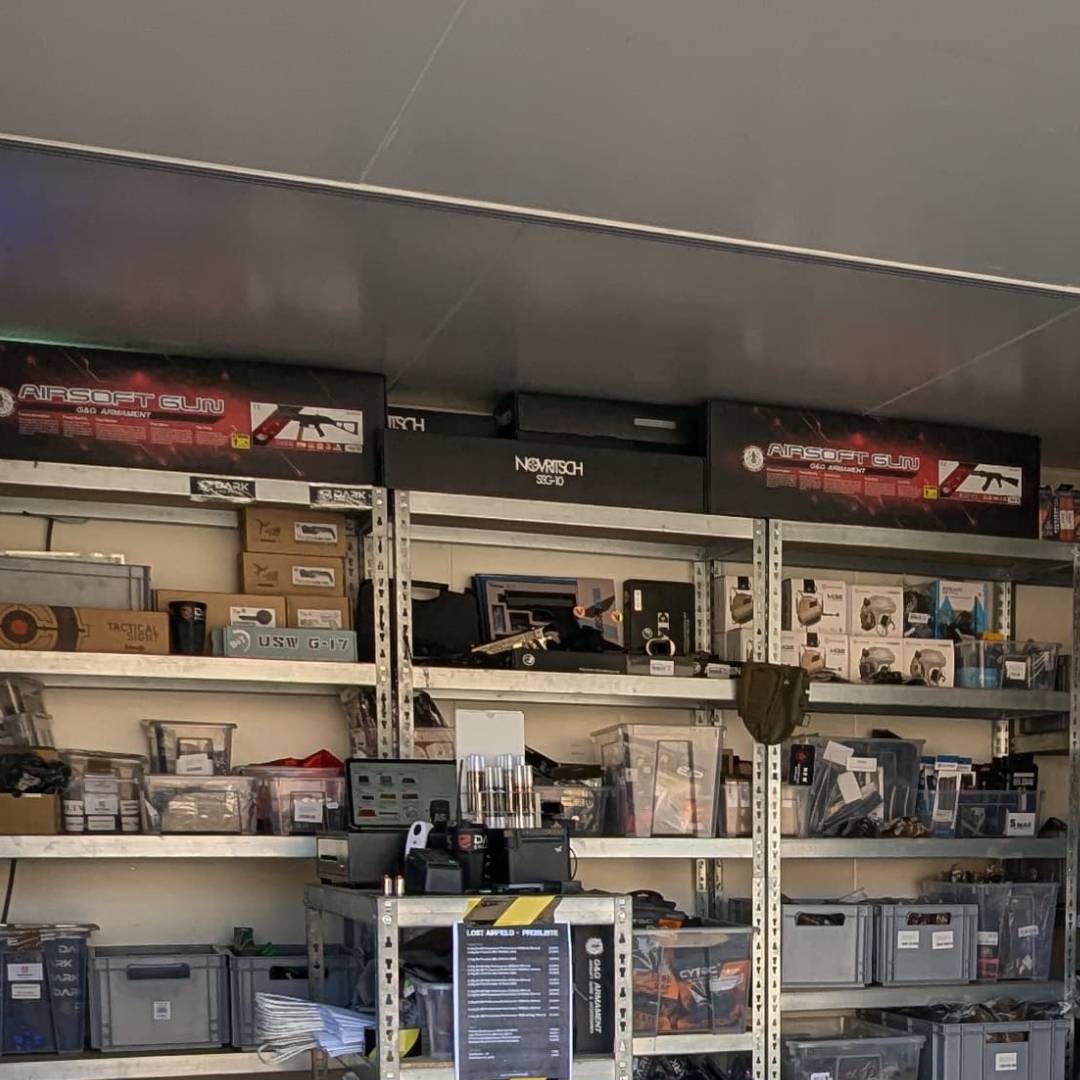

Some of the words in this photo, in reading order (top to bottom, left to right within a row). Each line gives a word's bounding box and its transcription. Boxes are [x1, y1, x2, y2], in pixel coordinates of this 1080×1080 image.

[17, 383, 156, 409] AIRSOFT
[158, 395, 225, 415] GUN
[75, 406, 97, 415] G&G
[100, 407, 152, 419] ARMAMENT
[766, 442, 869, 465] AIRSOFT
[871, 453, 921, 471] GUN
[515, 455, 583, 477] NOVRITSCH
[214, 479, 250, 493] DARK
[536, 474, 564, 487] SSG-10
[334, 488, 367, 501] DARK
[107, 621, 160, 635] TACTICAL
[257, 634, 300, 649] USW
[308, 637, 349, 651] G-17
[465, 929, 484, 937] LOST
[593, 981, 602, 1034] ARMAMENT
